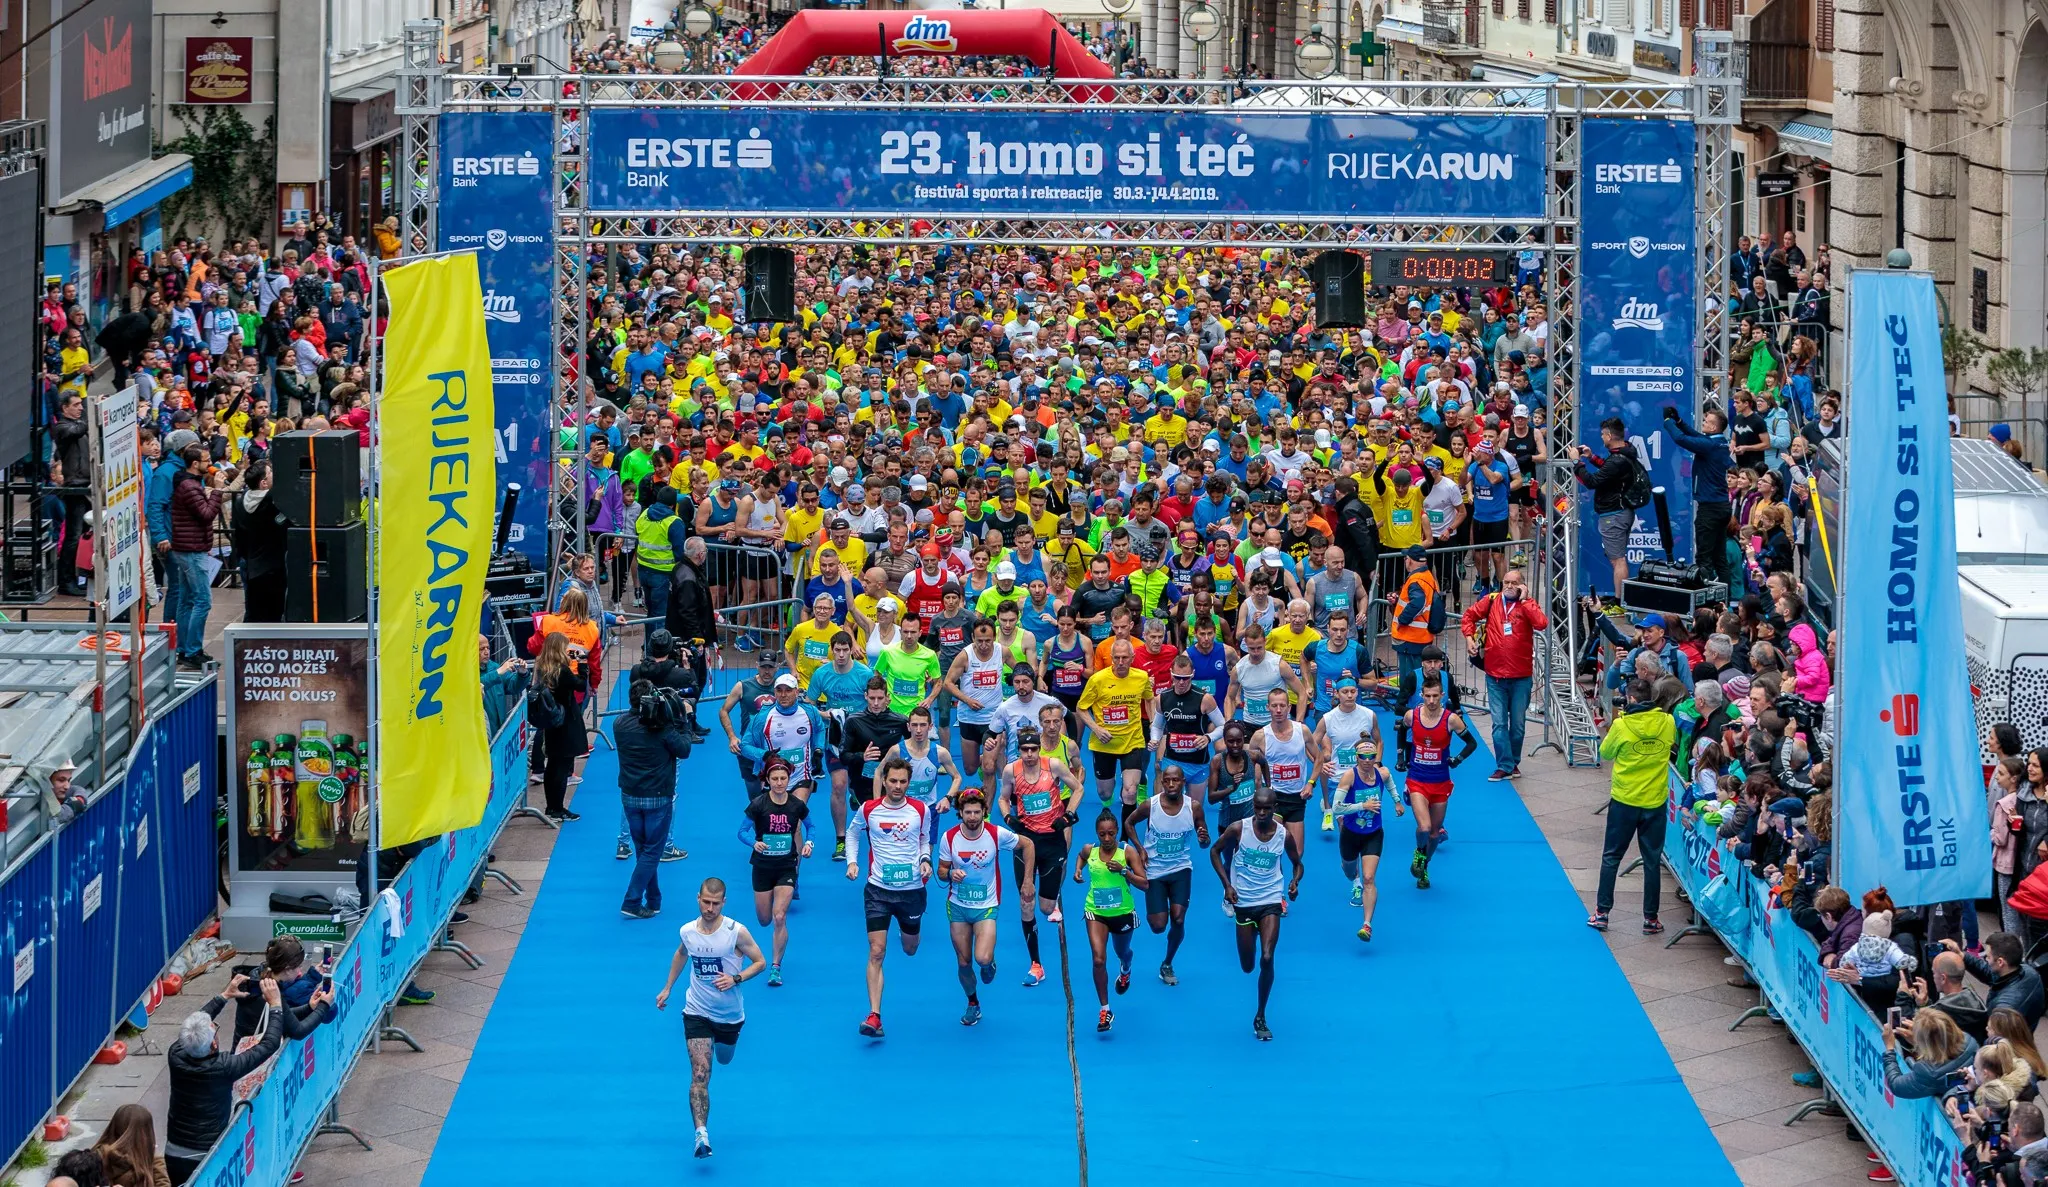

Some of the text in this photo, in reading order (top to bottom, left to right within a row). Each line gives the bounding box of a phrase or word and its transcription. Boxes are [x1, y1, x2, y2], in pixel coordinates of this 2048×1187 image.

[905, 16, 950, 41] dm
[196, 50, 242, 62] caffe bar
[627, 138, 730, 168] ERSTE
[880, 130, 1254, 177] 23. homo si teć
[452, 157, 514, 176] ERSTE
[1328, 152, 1513, 181] RIJEKARUN
[1595, 163, 1658, 183] ERSTE
[452, 177, 478, 187] Bank
[627, 171, 668, 188] Bank
[914, 184, 1219, 202] festival sporta i rekreacije 30.3.-14.4.2019.
[1595, 184, 1621, 194] Bank
[449, 235, 543, 243] SPORT VISION
[1591, 241, 1686, 250] SPORT VISION
[484, 289, 515, 312] dm
[1620, 296, 1658, 320] dm
[1884, 314, 1916, 412] TEĆ
[1597, 367, 1671, 375] INTERSPAR
[1635, 382, 1671, 390] SPAR
[109, 397, 136, 426] kamgrad
[1628, 430, 1662, 471] A1
[1896, 425, 1919, 476] SI
[415, 369, 470, 720] RIJEKARUN
[1887, 488, 1920, 644] HOMO
[927, 605, 940, 613] 517
[243, 646, 340, 662] ZAŠTO BIRATI,
[812, 646, 825, 654] 251
[243, 660, 327, 674] AKO MOŽEŠ
[244, 676, 301, 688] PROBATI
[982, 675, 996, 683] 576
[244, 690, 336, 702] SVAKI OKUS?
[1124, 694, 1137, 702] your
[1111, 711, 1126, 719] 554
[1164, 708, 1197, 721] Aminess
[1179, 739, 1193, 747] 613
[297, 749, 318, 758] fuze
[789, 754, 799, 762] 49
[246, 761, 264, 769] fuze
[270, 757, 289, 766] fuze
[1282, 770, 1297, 778] 594
[321, 783, 342, 795] NOVO
[1032, 798, 1048, 808] 192
[1896, 744, 1936, 871] ERSTE
[769, 813, 788, 824] RUN
[776, 841, 786, 849] 32
[1937, 817, 1957, 867] Bank
[1254, 856, 1271, 865] 266
[893, 870, 909, 879] 408
[968, 890, 983, 899] 108
[1107, 894, 1114, 902] 9
[289, 924, 339, 935] europlakat
[701, 964, 719, 973] 840
[1797, 948, 1821, 1012] ERSTE
[1854, 1024, 1884, 1095] ERSTE
